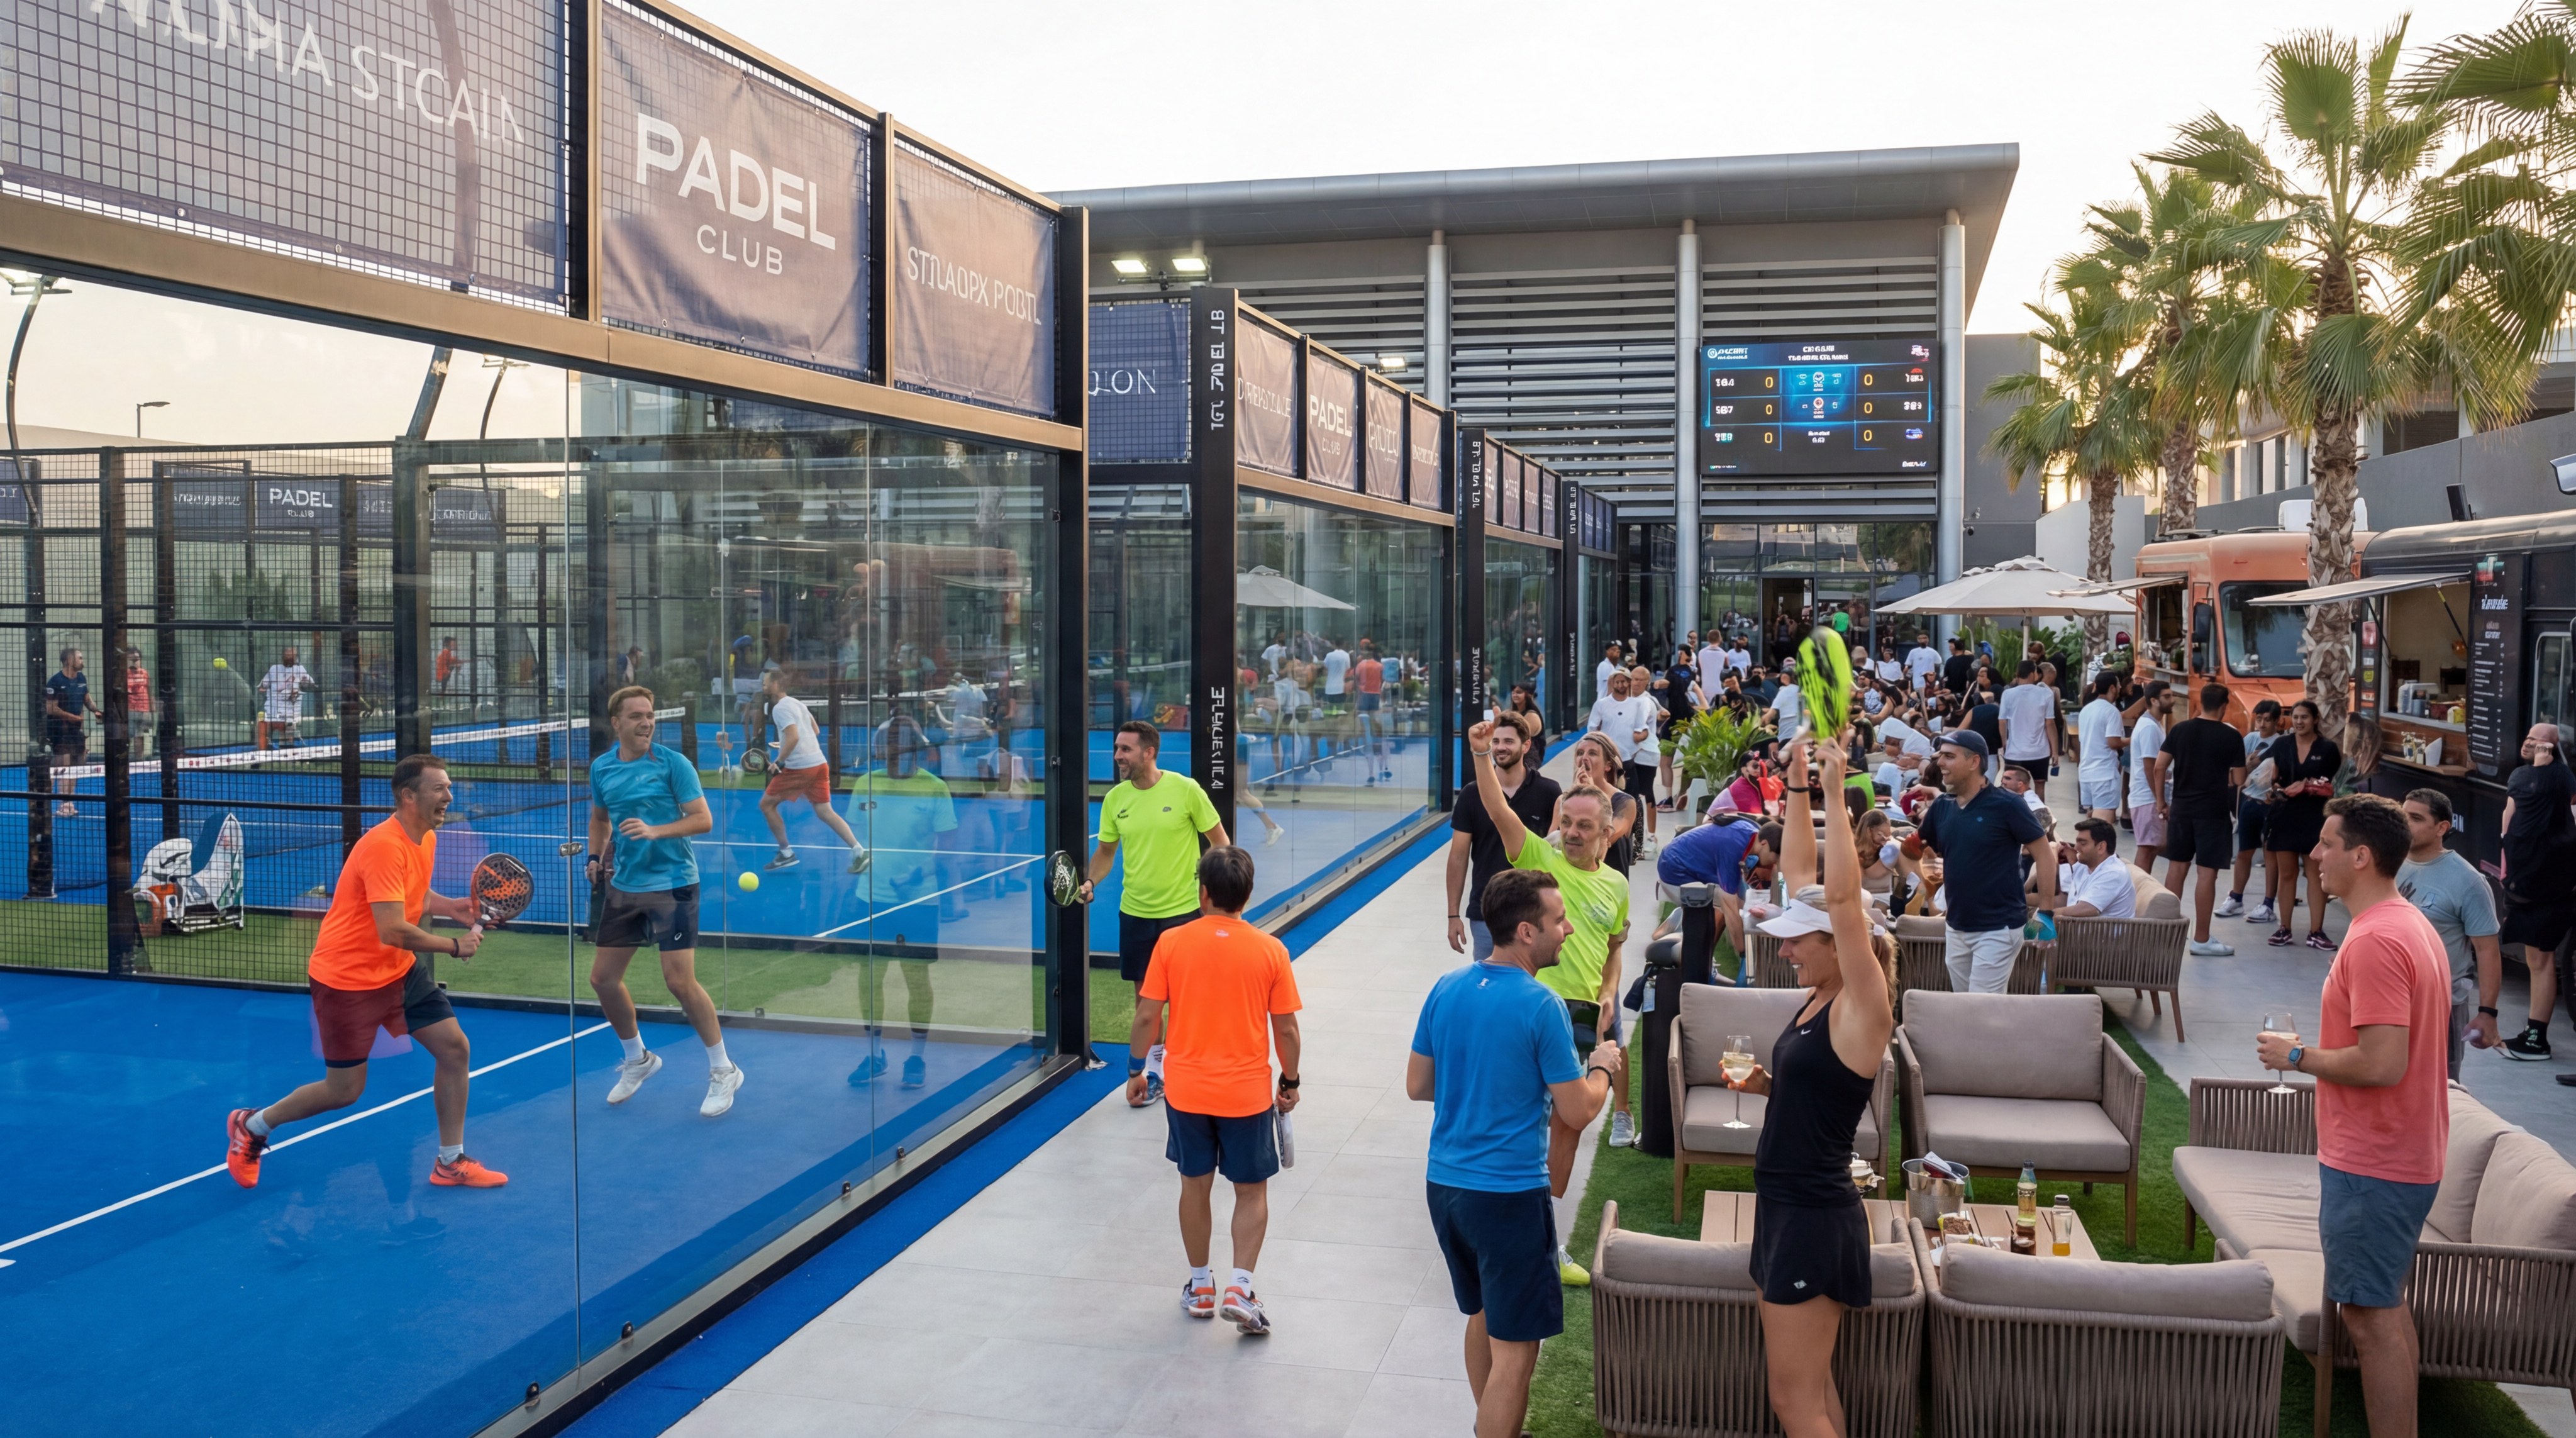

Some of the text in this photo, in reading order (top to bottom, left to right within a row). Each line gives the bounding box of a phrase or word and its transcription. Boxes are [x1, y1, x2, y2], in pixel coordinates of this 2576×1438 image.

[636, 112, 836, 250] PADEL
[697, 224, 782, 275] CLUB
[1765, 376, 1774, 388] 0
[1863, 374, 1873, 386] 0
[1765, 404, 1773, 415] 0
[1863, 402, 1873, 414] 0
[1310, 394, 1352, 437] PADEL
[1764, 432, 1773, 443] 0
[1863, 430, 1873, 442] 0
[270, 488, 333, 508] PADEL
